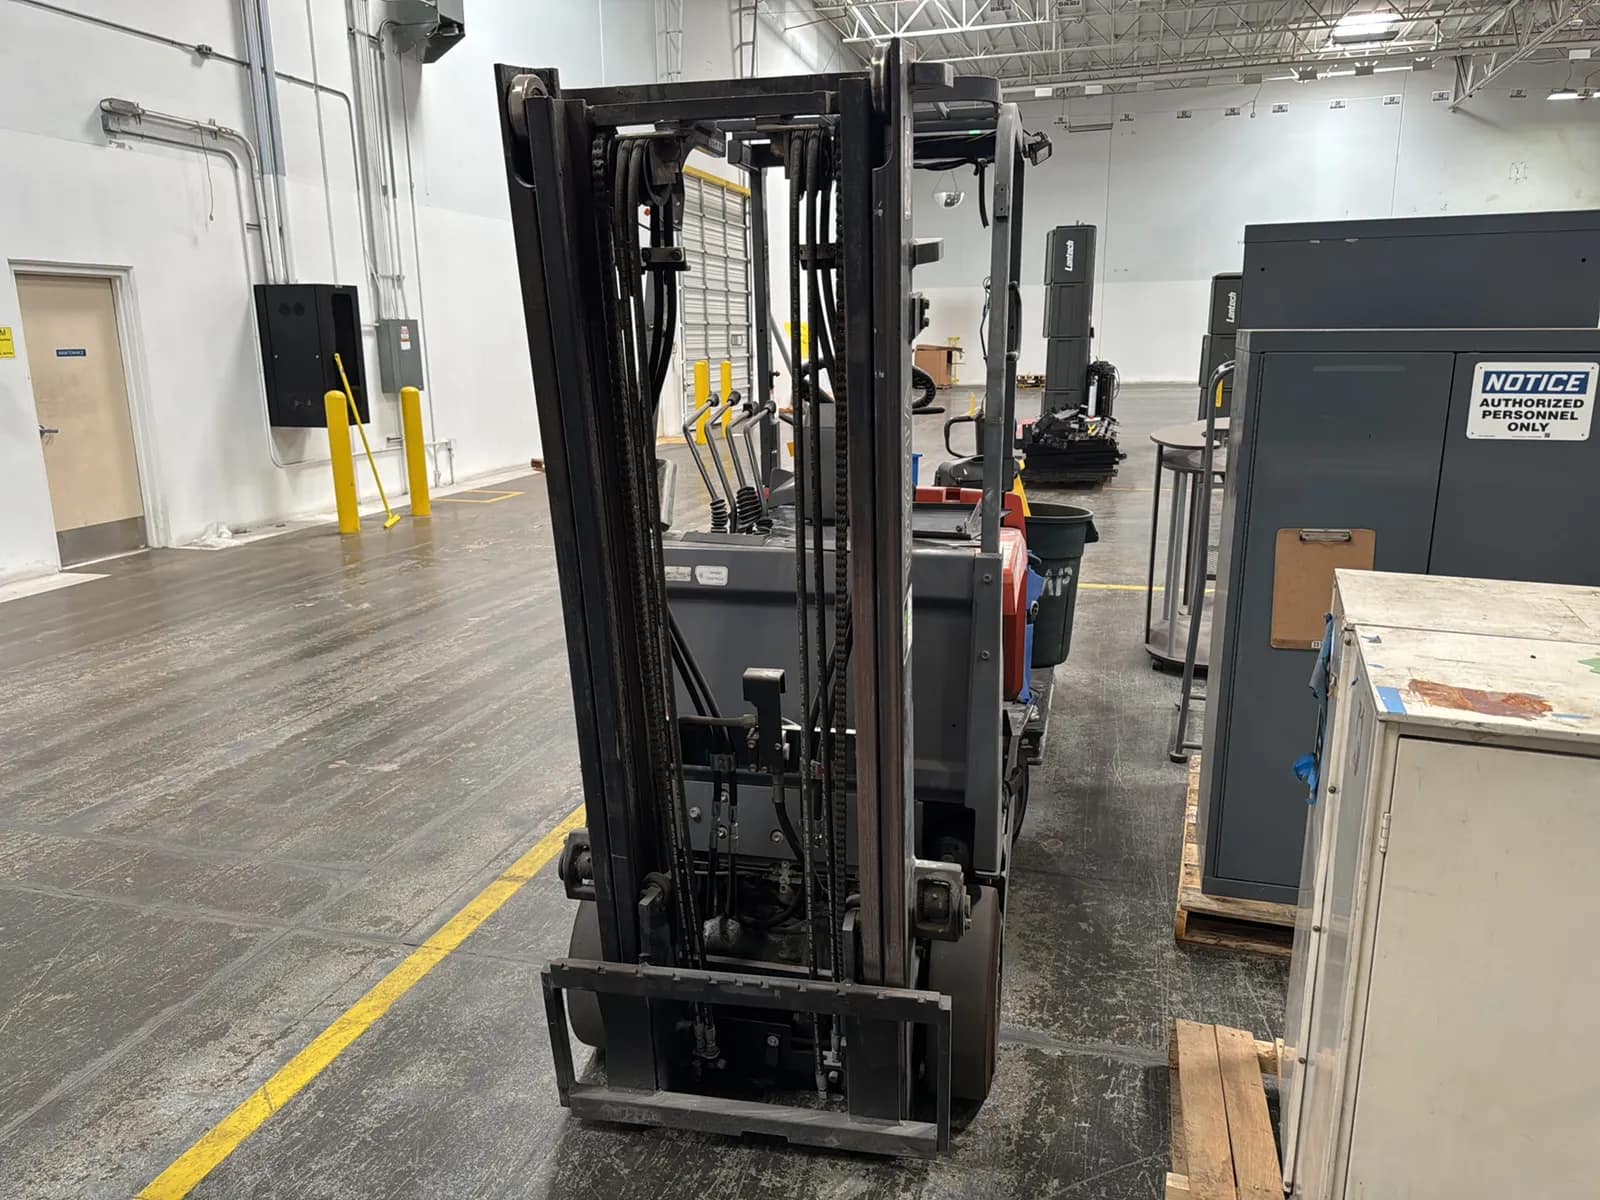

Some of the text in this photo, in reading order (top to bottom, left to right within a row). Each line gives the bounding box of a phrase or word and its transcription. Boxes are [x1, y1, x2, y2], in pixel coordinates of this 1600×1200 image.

[1065, 240, 1074, 271] Lantech
[1226, 291, 1237, 323] Lantech
[1485, 374, 1586, 392] NOTICE
[1480, 398, 1585, 409] AUTHORIZED
[1482, 410, 1579, 421] PERSONNEL
[1507, 422, 1550, 432] ONLY
